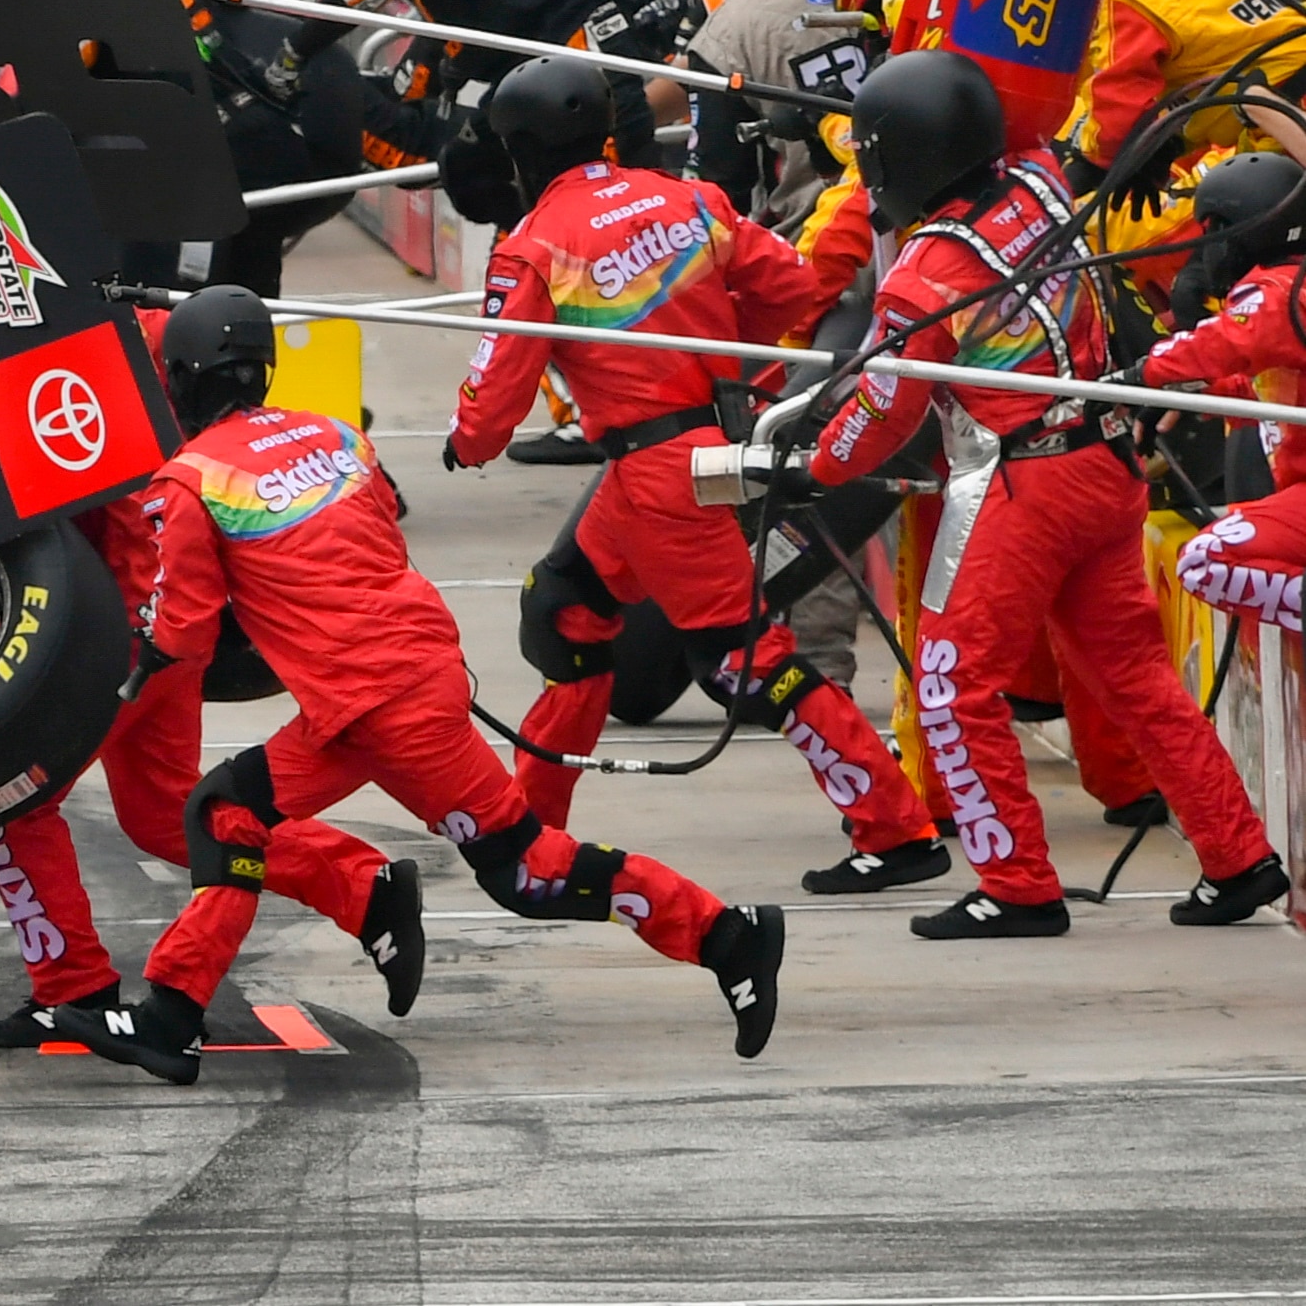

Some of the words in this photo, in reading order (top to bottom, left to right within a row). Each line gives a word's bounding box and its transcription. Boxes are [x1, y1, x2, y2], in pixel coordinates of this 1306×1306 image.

[589, 194, 666, 230] CORDERO
[592, 214, 710, 299] Skittles
[248, 423, 324, 453] HOUSTON
[829, 404, 874, 463] Skittles
[918, 637, 1016, 866] Skittles
